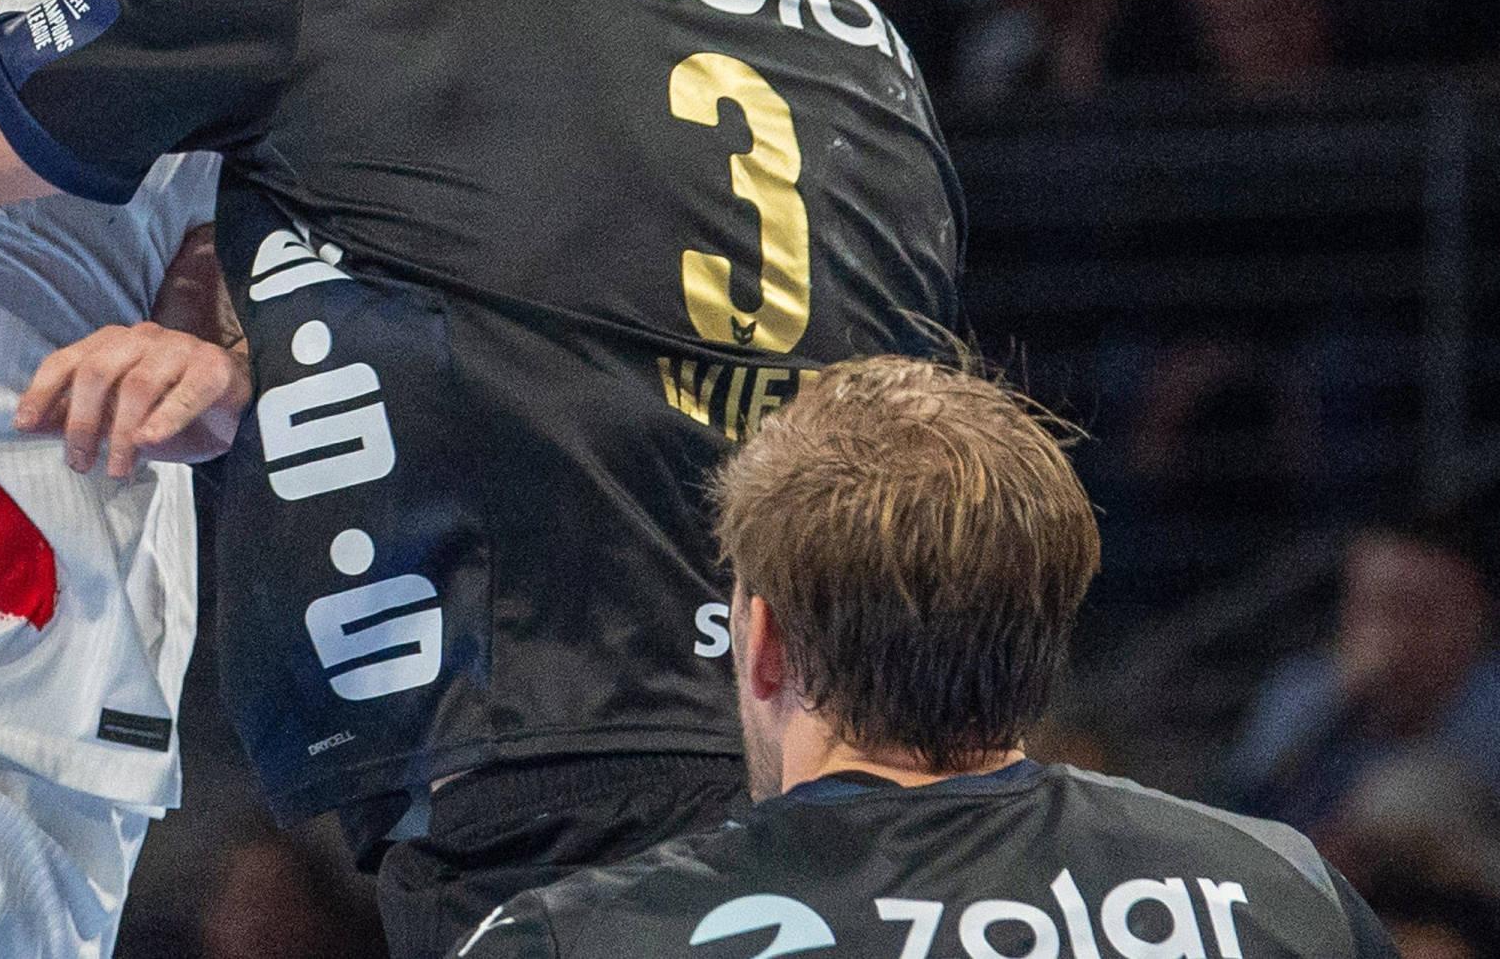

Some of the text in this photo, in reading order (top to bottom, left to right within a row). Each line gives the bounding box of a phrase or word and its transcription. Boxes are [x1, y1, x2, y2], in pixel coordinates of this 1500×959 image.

[26, 5, 53, 51] LEAGUE
[669, 52, 811, 354] 3
[874, 868, 1248, 959] zolar
